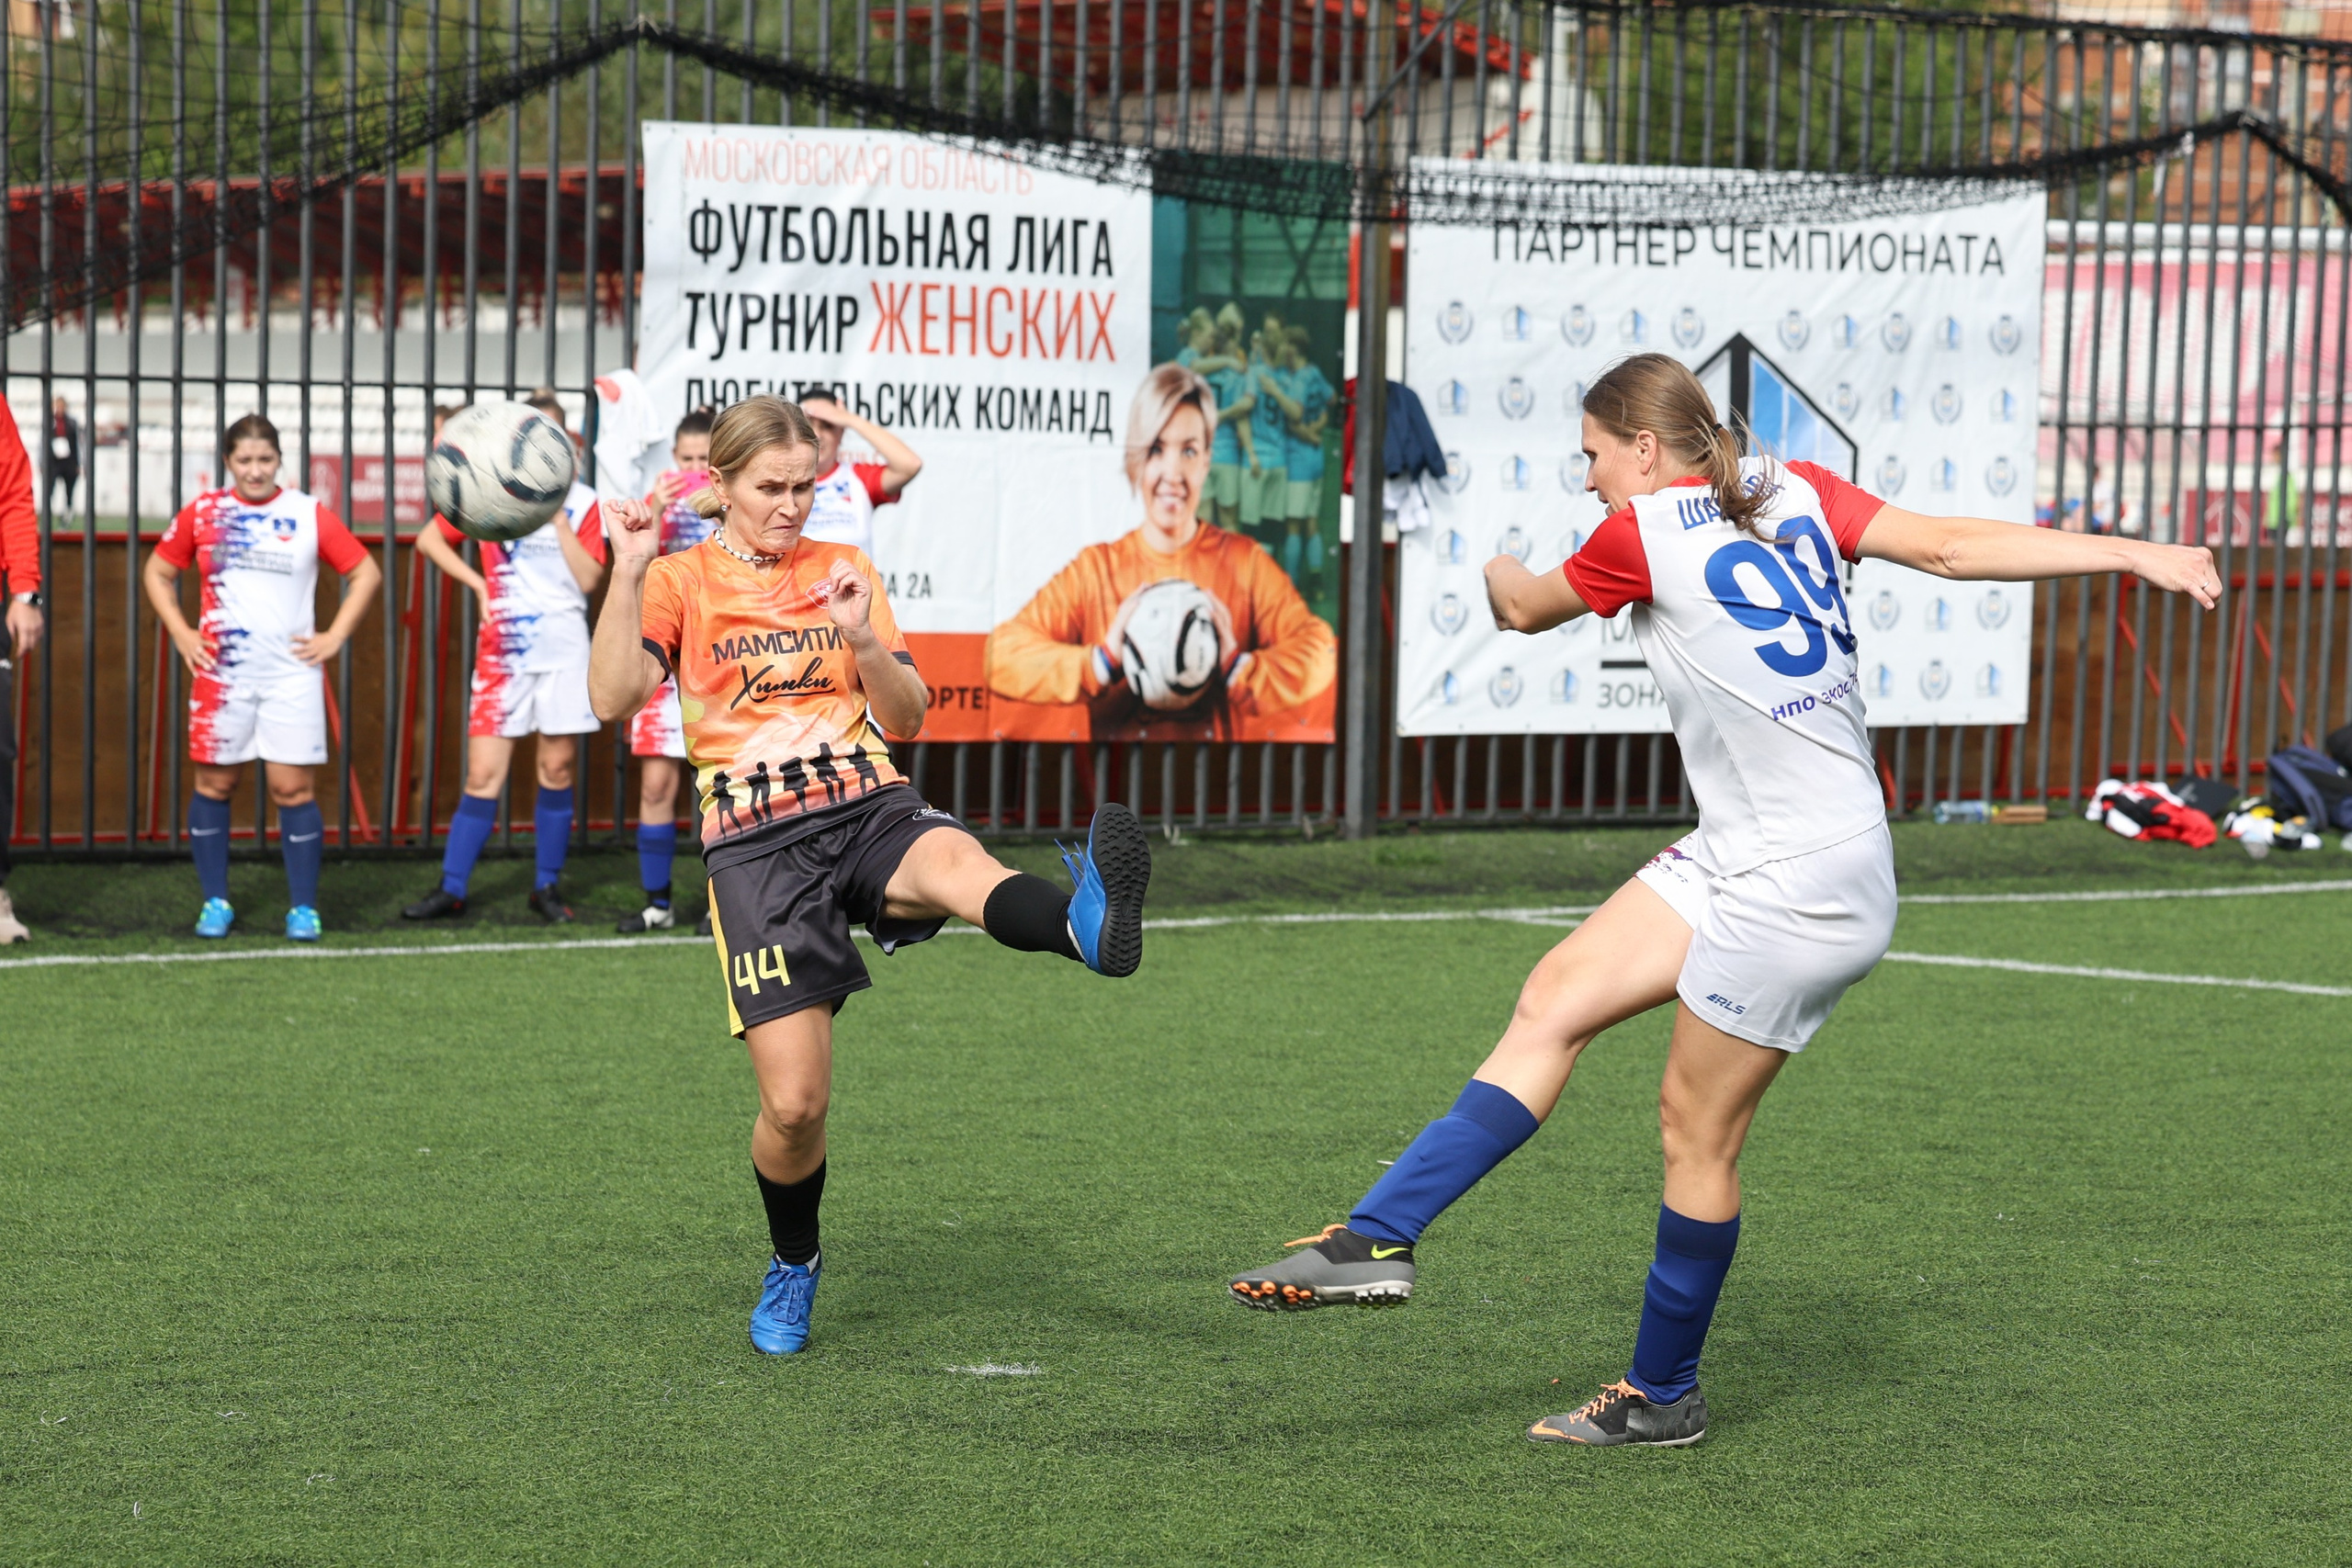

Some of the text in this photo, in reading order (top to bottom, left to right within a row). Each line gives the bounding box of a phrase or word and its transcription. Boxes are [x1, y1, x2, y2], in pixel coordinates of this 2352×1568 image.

[684, 137, 1035, 196] МОСКОВСКАЯ ОБЛАСТЬ
[689, 198, 1113, 276] ФУТБОЛЬНАЯ ЛИГА
[1494, 220, 2005, 276] ПАРТНЕР ЧЕМПИОНАТА
[685, 281, 1116, 362] ТУРНИР ЖЕНСКИХ
[976, 386, 1113, 442] КОМАНД
[1704, 513, 1858, 677] 99
[712, 626, 842, 665] МАМСИТИ
[1770, 695, 1815, 721] НПО
[735, 944, 791, 995] 44
